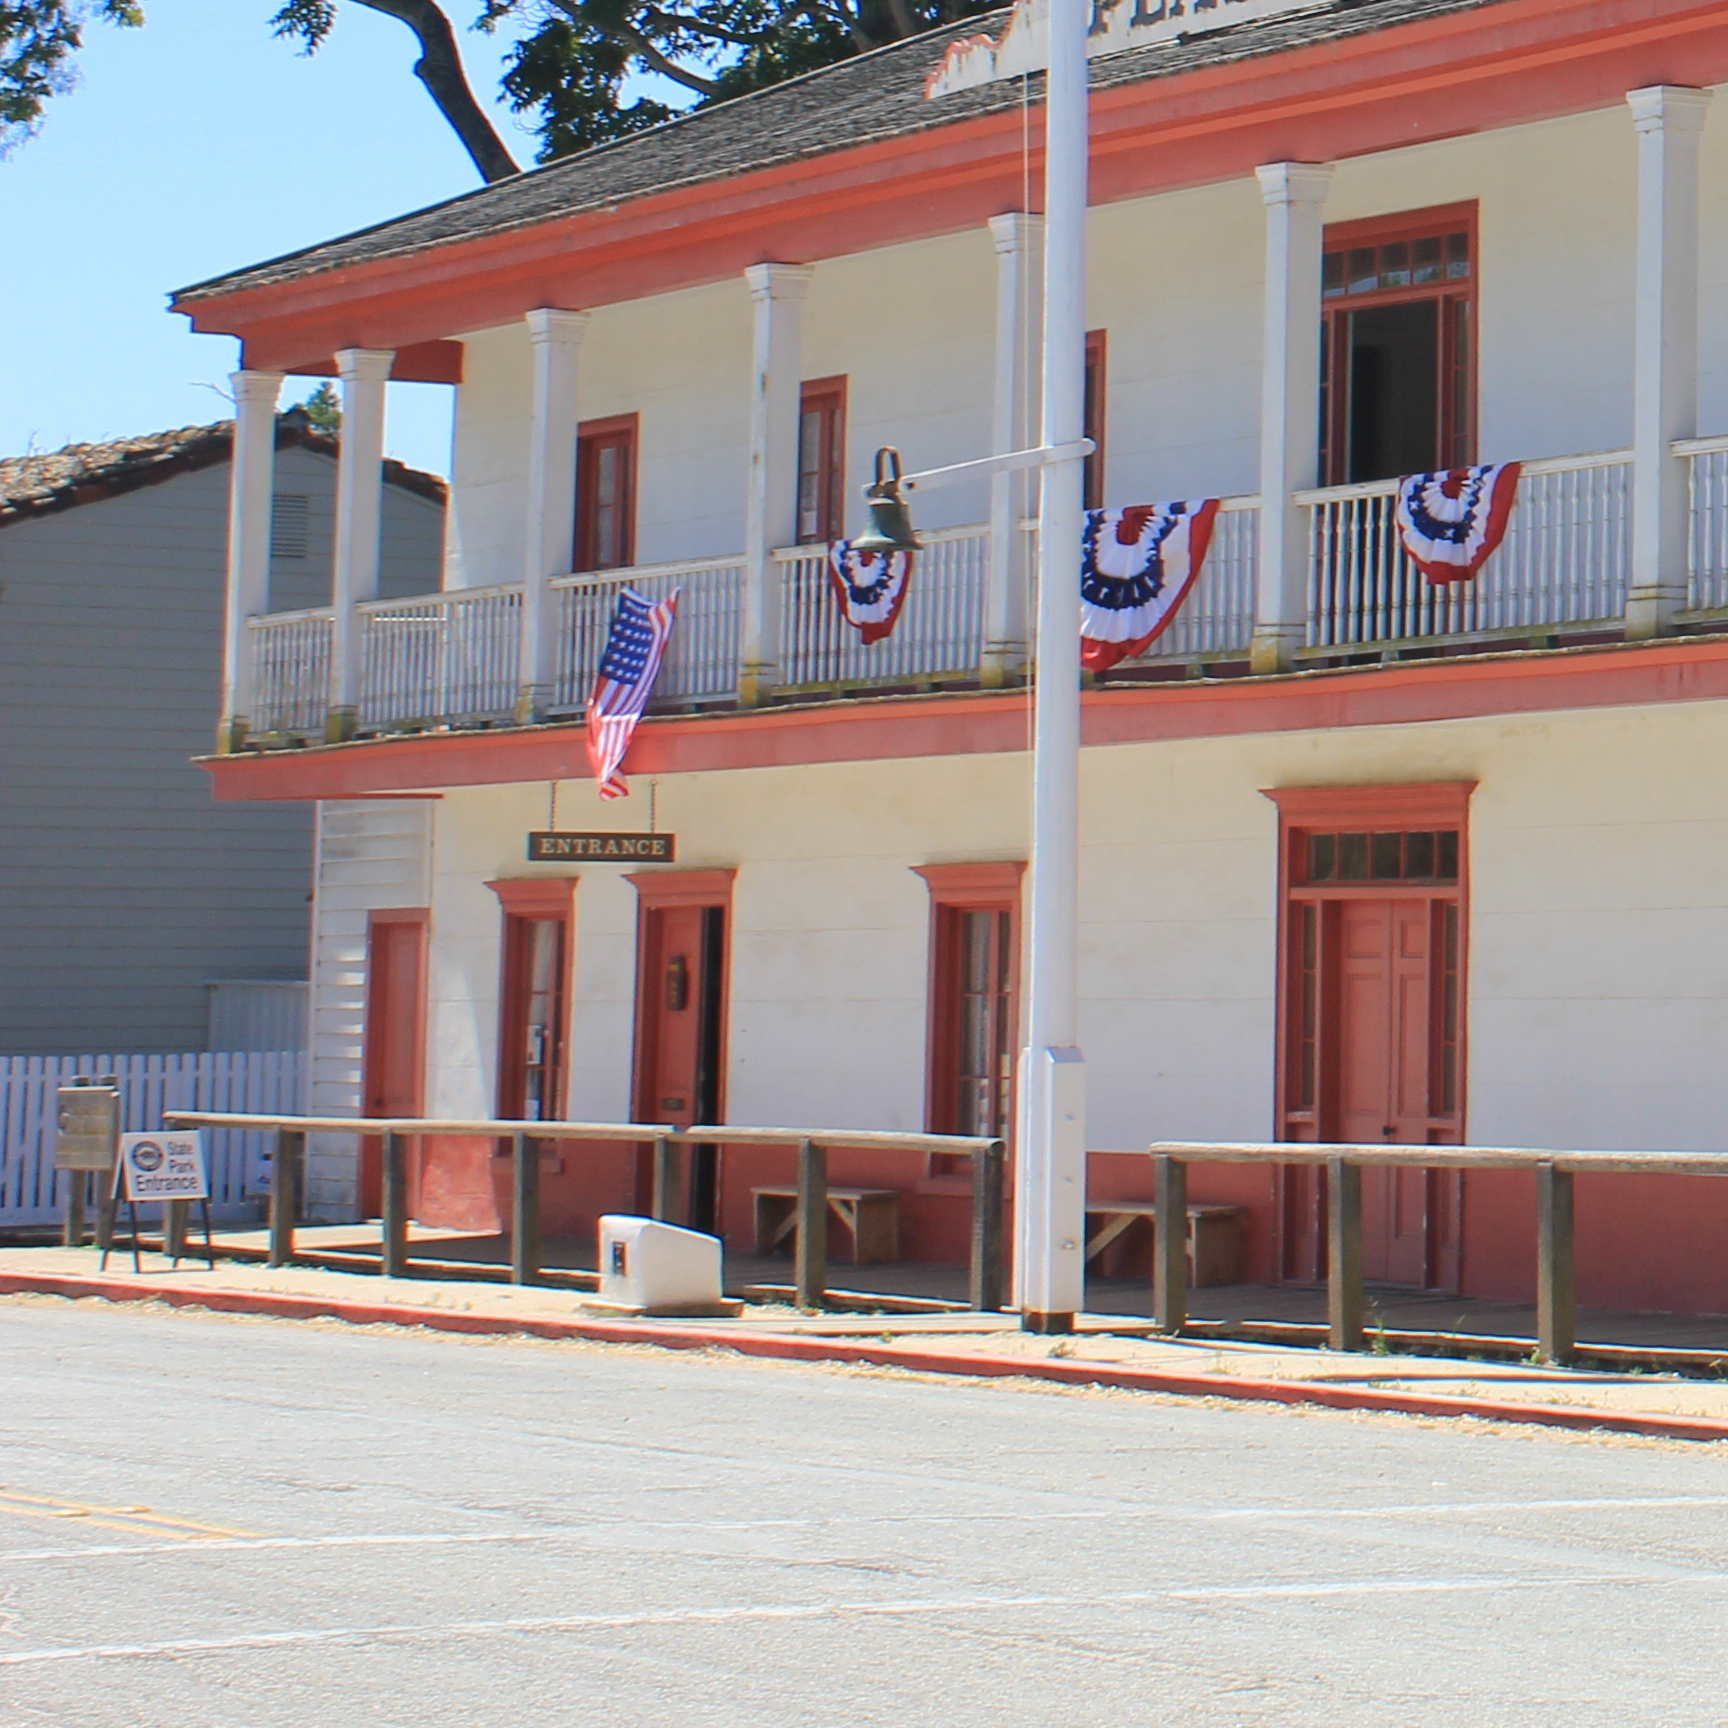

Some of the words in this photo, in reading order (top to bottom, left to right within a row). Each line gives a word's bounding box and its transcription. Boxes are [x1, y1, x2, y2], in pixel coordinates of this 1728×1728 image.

[540, 837, 666, 856] ENTRANCE
[168, 1140, 193, 1155] State
[170, 1159, 196, 1173] Park
[136, 1174, 198, 1191] Entrance
